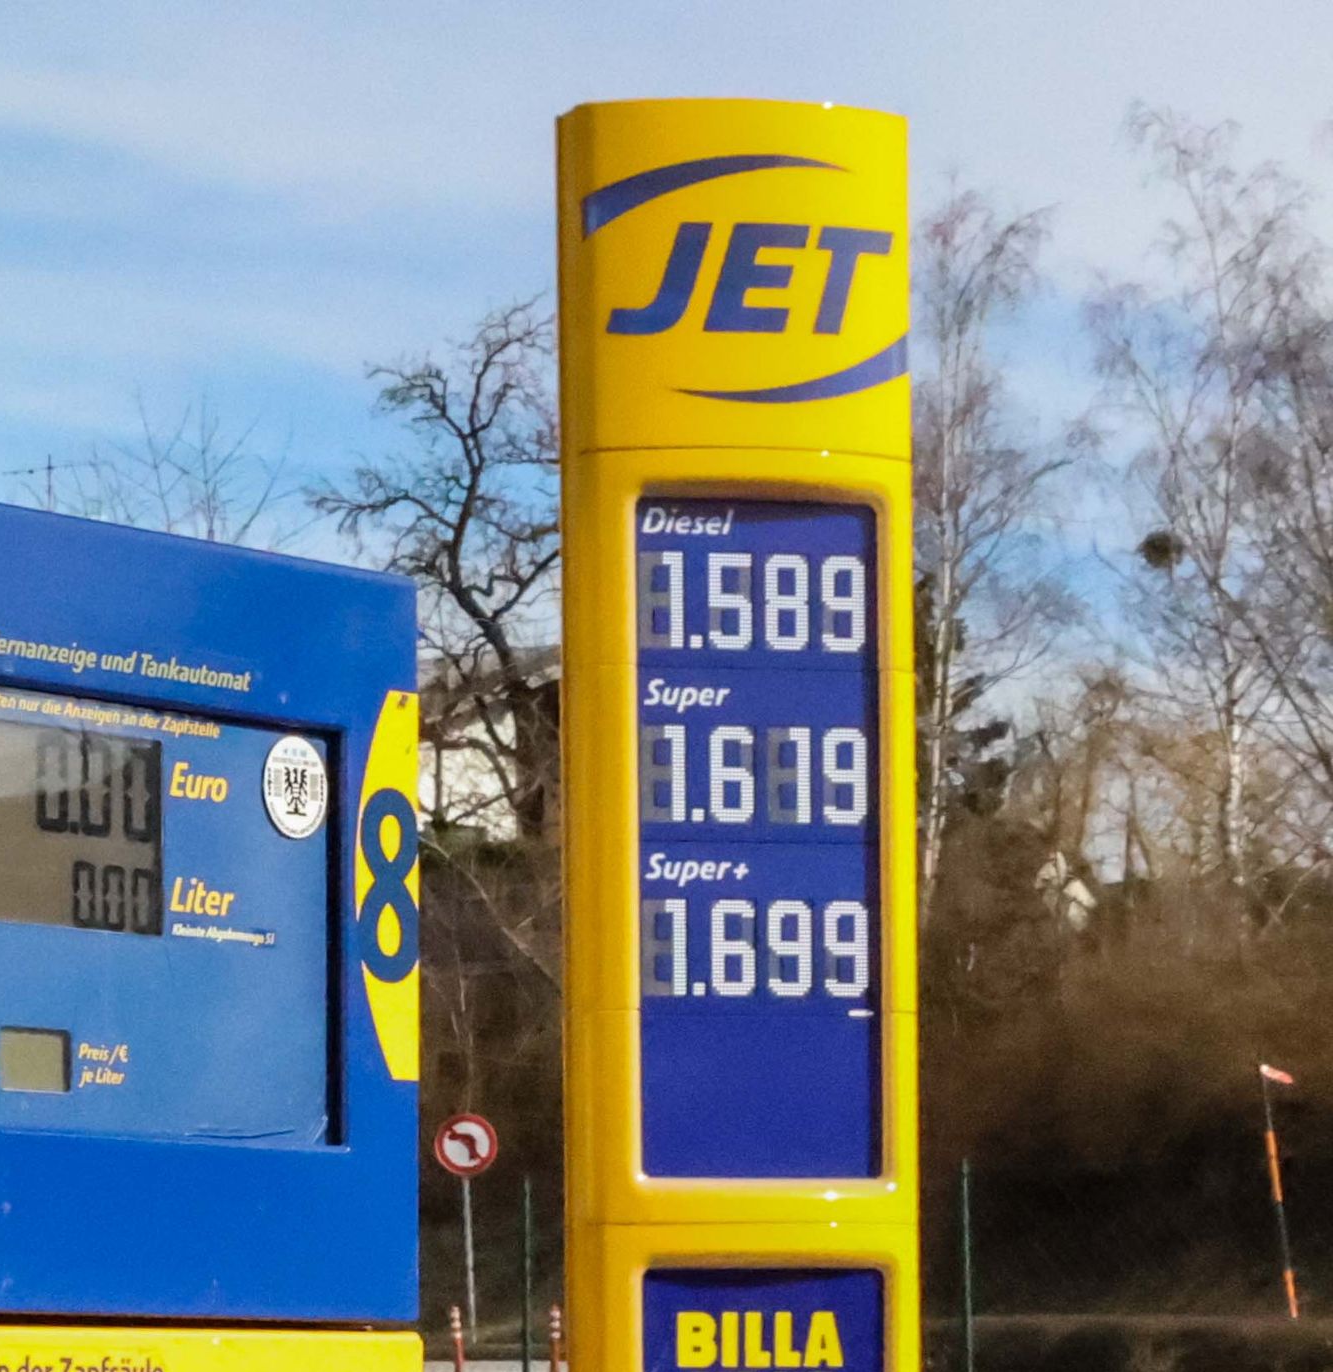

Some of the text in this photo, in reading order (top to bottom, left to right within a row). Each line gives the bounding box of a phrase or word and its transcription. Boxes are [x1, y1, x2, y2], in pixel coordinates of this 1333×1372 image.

[606, 222, 894, 336] JET
[641, 506, 735, 537] Diesel
[662, 551, 866, 652] 1.589
[101, 651, 137, 675] und
[140, 653, 251, 692] Tankautomat
[644, 679, 730, 712] Super
[19, 699, 39, 713] nur
[42, 699, 61, 714] die
[63, 702, 120, 726] Anzeigen
[122, 712, 136, 724] an
[139, 712, 160, 729] der
[162, 715, 220, 739] Zapfstelle
[170, 762, 227, 802] Euro
[663, 725, 867, 826] 1.619
[358, 788, 418, 982] 8
[645, 853, 750, 887] Super+
[170, 877, 234, 916] Liter
[664, 898, 868, 998] 1.699
[78, 1042, 110, 1061] Preis
[78, 1066, 125, 1088] je Liter
[676, 1311, 843, 1368] BILLA
